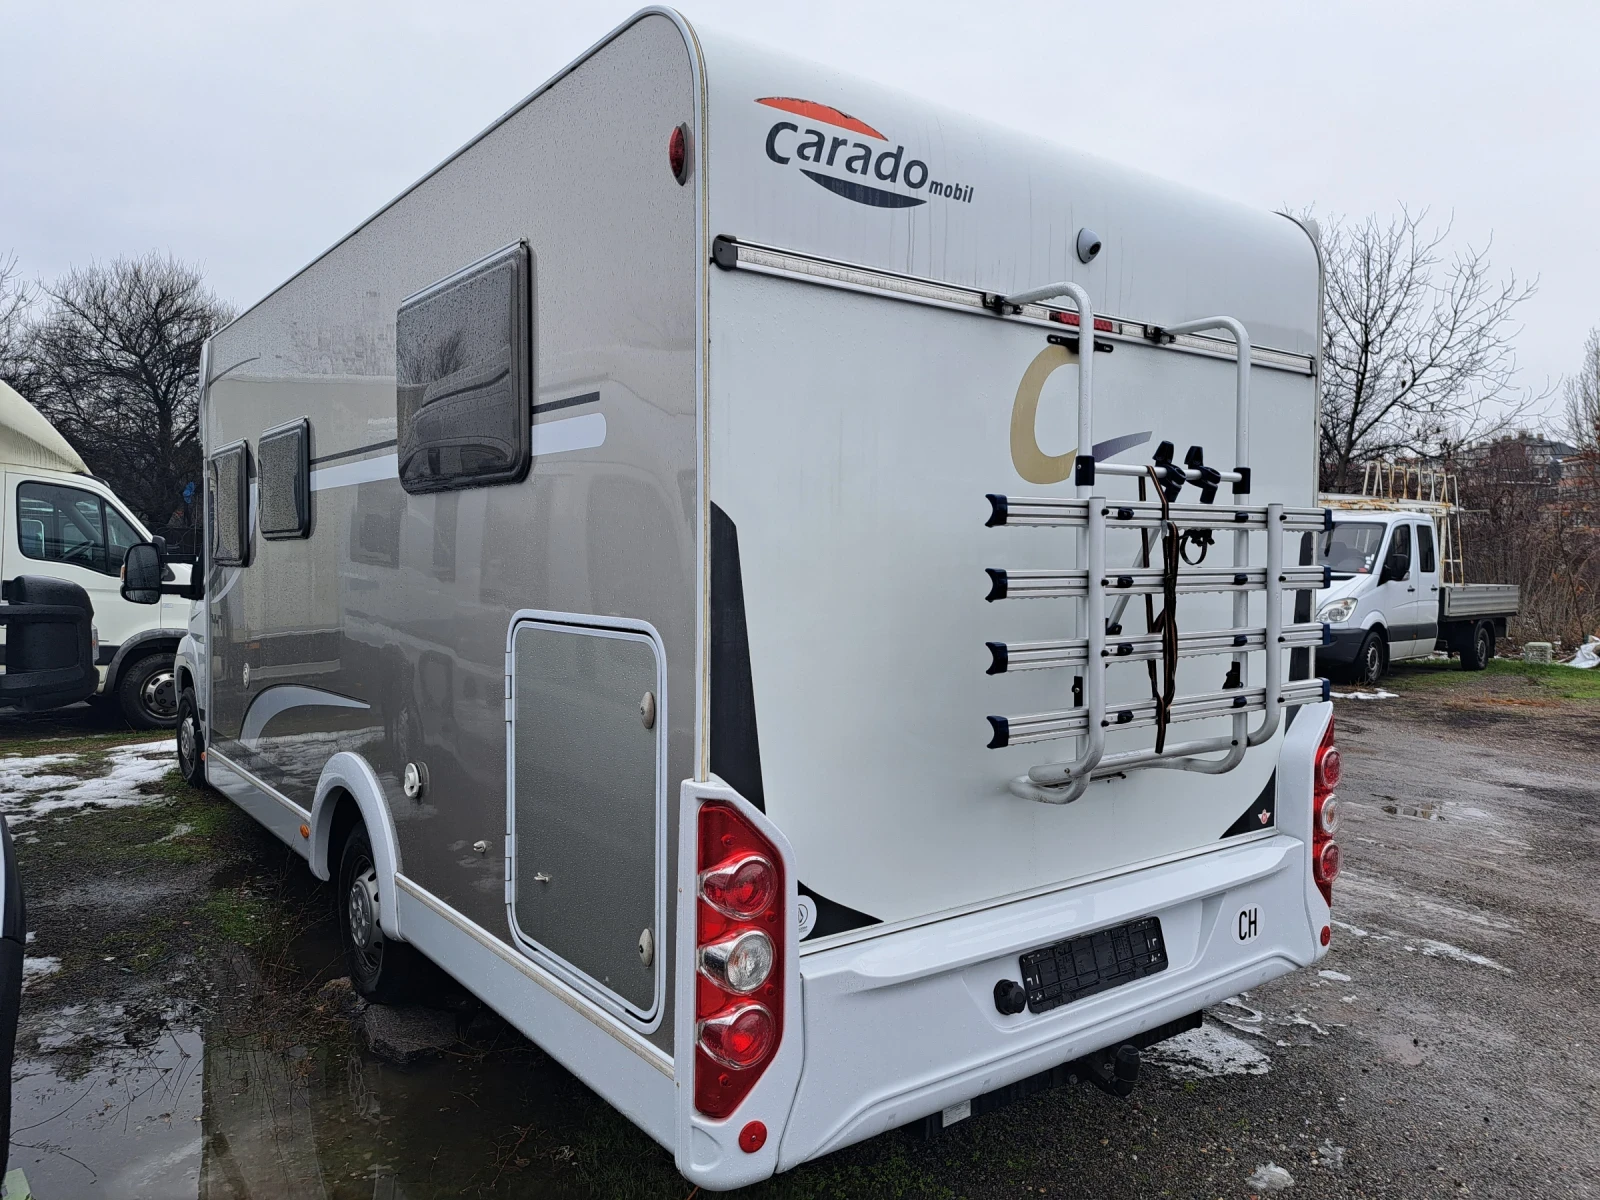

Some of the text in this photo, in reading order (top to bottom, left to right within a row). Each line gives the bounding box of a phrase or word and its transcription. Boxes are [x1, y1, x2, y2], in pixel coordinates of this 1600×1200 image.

[765, 121, 974, 203] Carado mobil
[1239, 908, 1257, 940] CH
